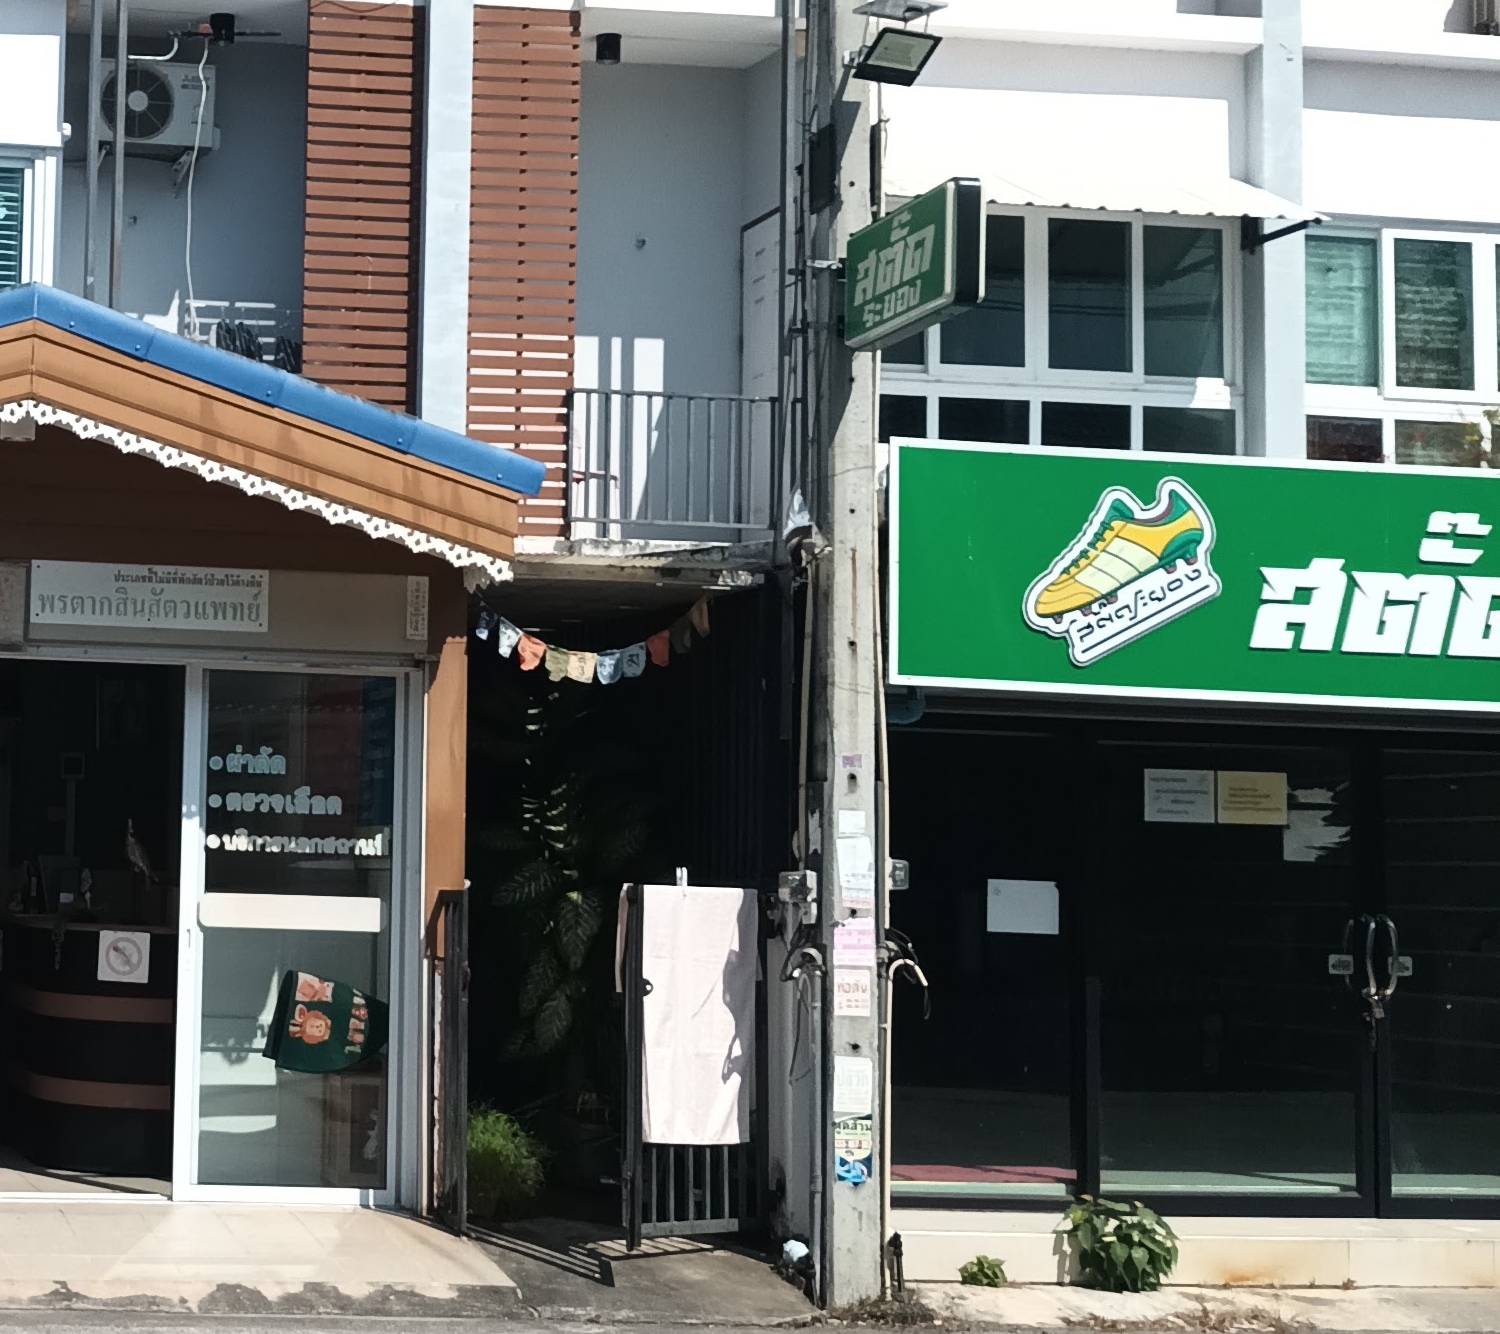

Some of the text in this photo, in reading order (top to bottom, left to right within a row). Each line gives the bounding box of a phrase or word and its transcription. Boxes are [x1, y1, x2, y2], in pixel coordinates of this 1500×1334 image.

[862, 279, 922, 328] ระยอง
[37, 586, 263, 623] พรตากสินสัตวแพทย์
[226, 744, 287, 774] ผ่าตัด
